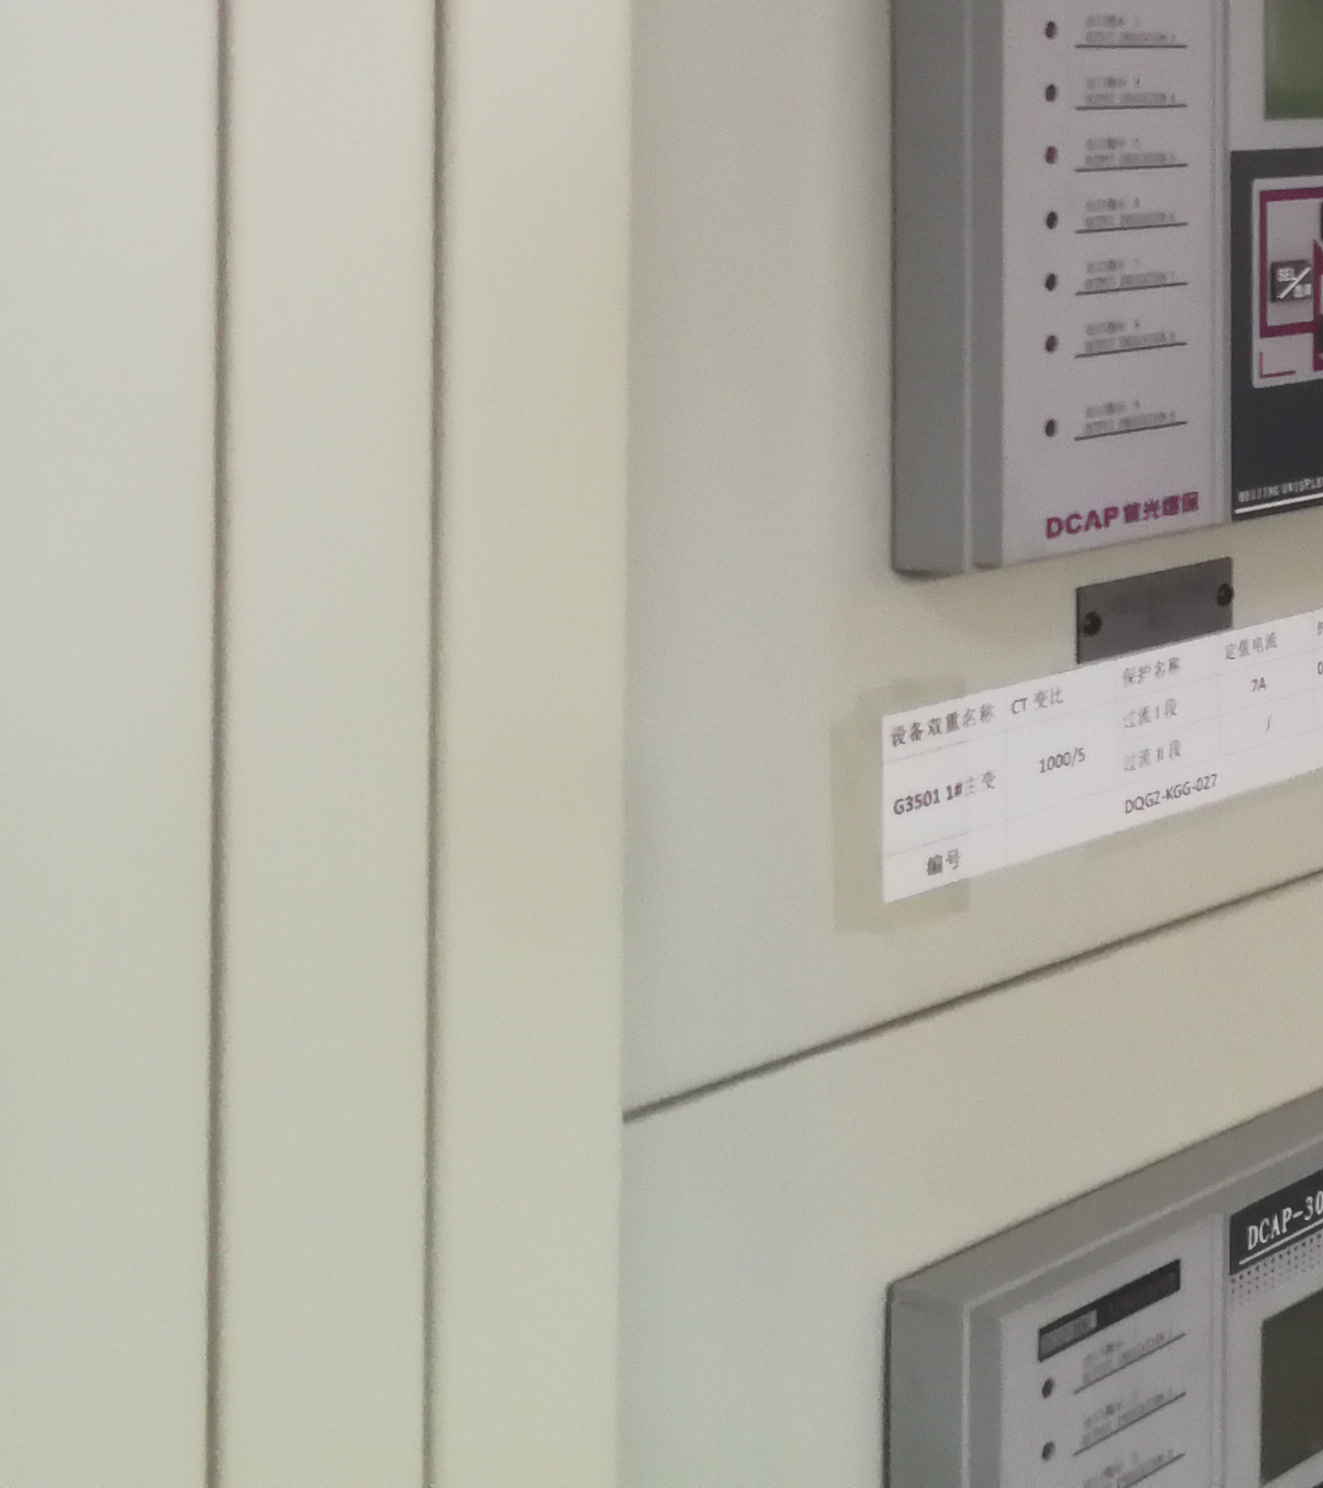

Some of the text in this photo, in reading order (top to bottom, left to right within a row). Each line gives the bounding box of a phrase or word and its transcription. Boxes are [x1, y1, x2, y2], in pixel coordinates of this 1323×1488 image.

[1046, 506, 1120, 539] DCAP
[1251, 677, 1267, 693] 7A
[1011, 697, 1028, 715] CT
[1039, 748, 1086, 774] 1000/5
[893, 788, 942, 816] G3501
[927, 849, 961, 877] 编号
